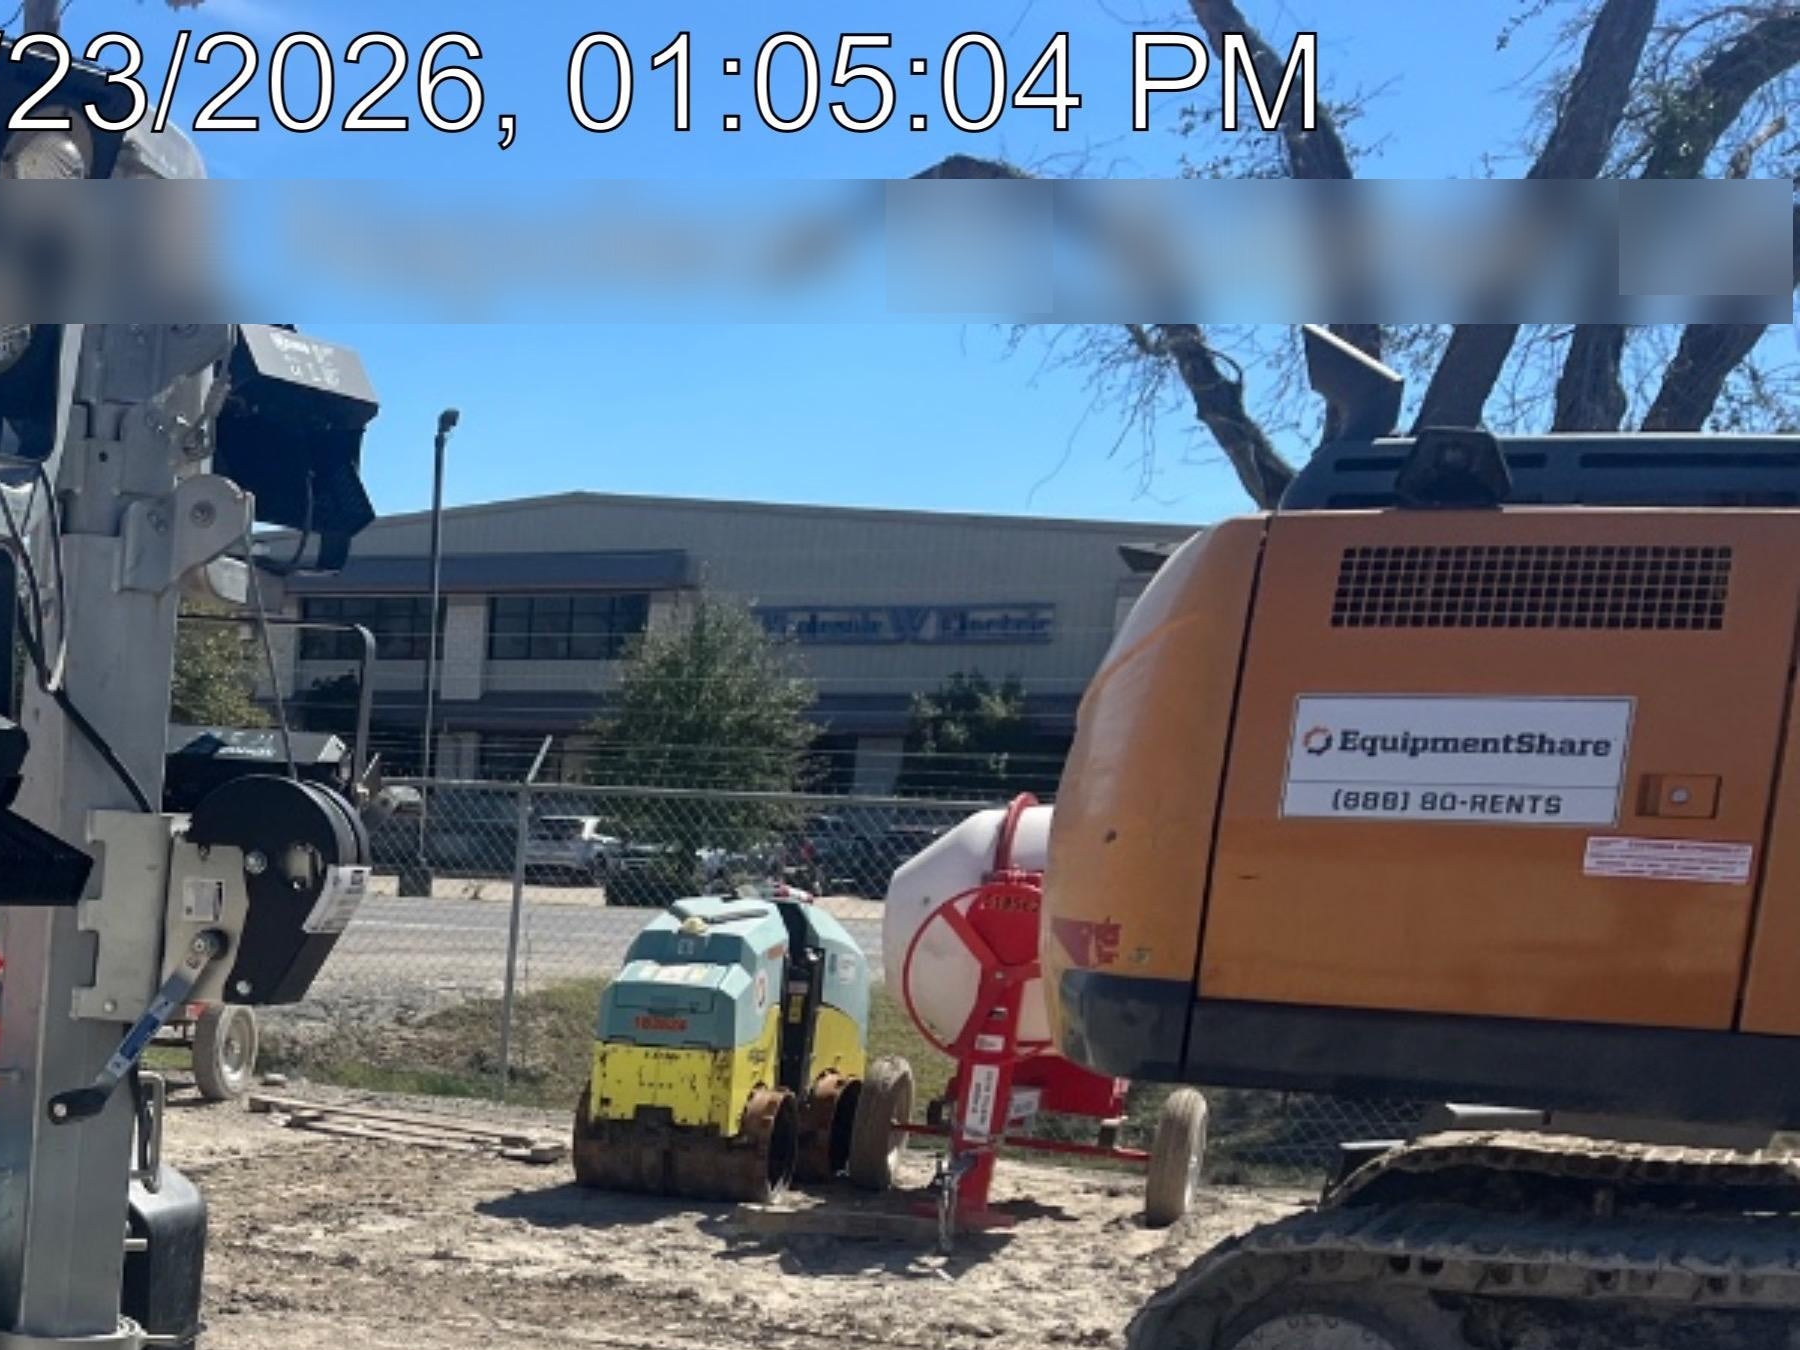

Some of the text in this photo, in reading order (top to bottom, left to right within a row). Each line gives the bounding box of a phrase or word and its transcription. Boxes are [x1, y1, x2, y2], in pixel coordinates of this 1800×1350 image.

[1338, 729, 1612, 758] EquipmentShare
[1331, 787, 1563, 816] (888) 80-RENTS
